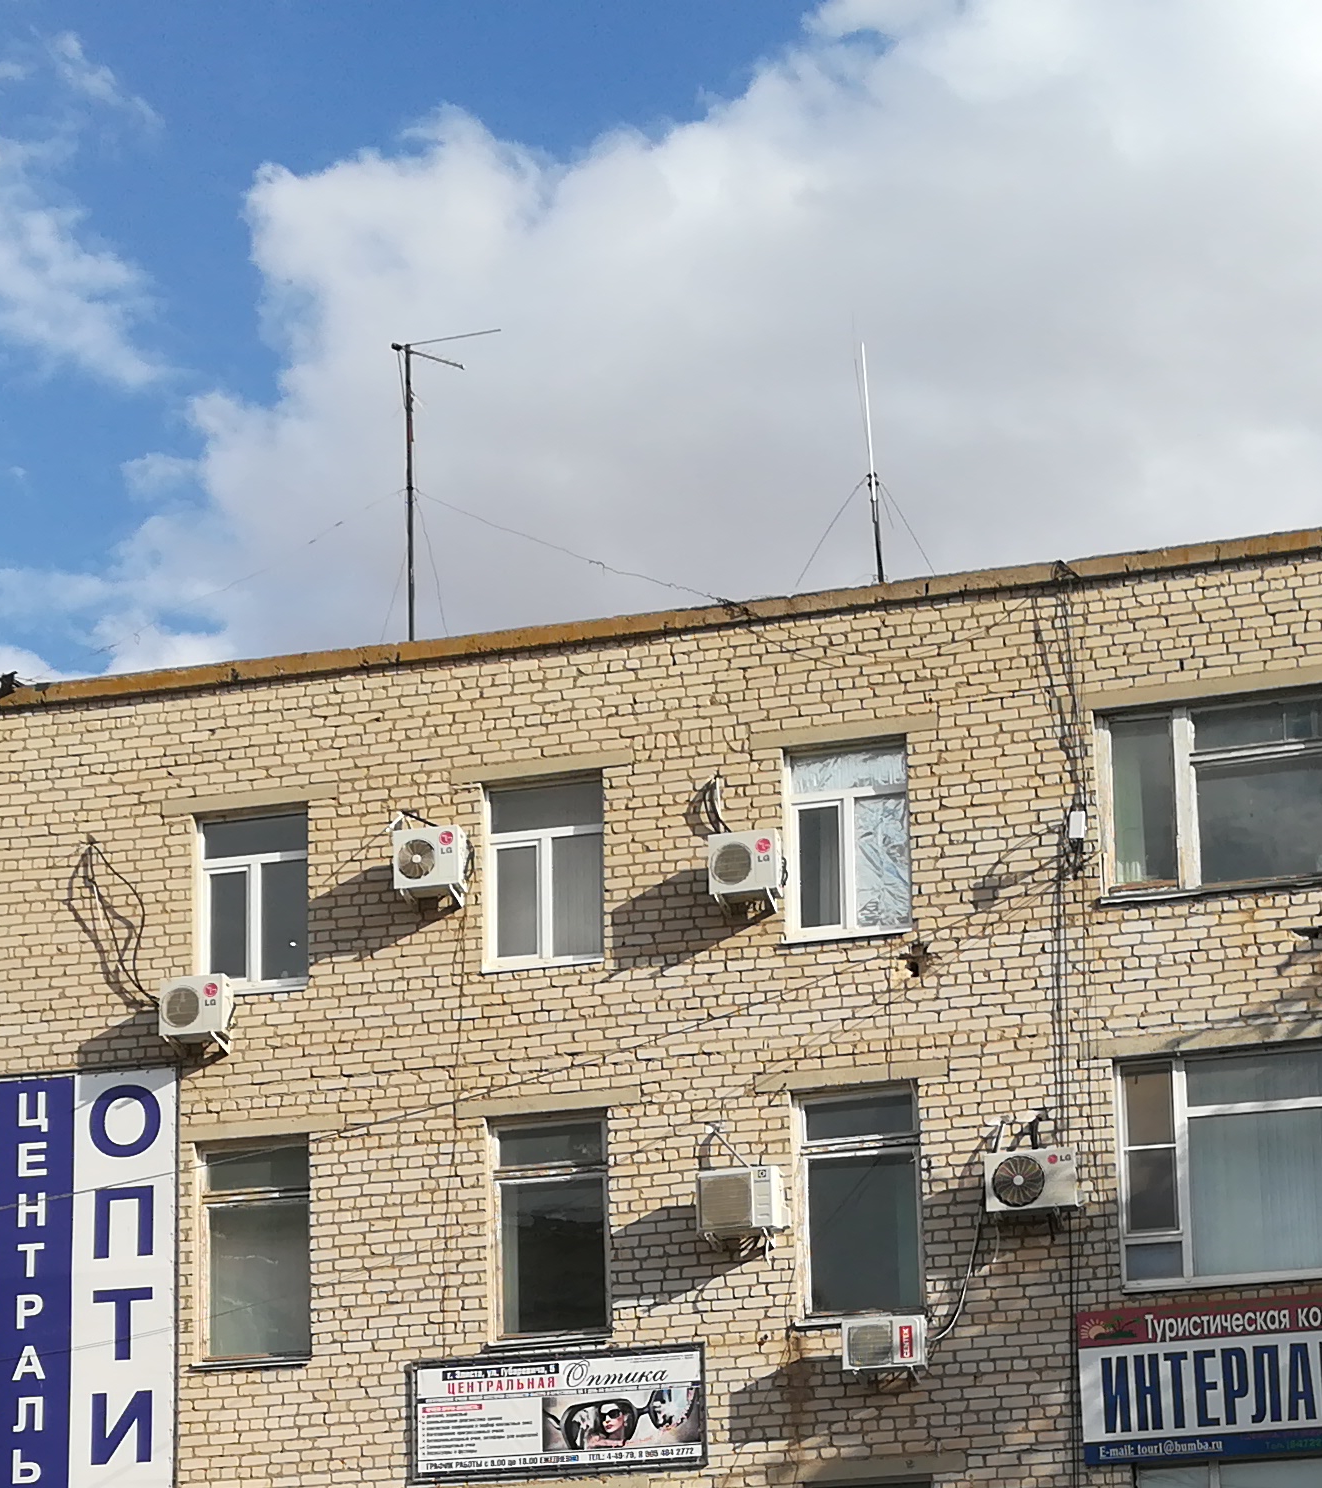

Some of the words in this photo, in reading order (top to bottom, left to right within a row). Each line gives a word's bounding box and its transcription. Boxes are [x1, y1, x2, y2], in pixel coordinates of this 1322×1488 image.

[1144, 1308, 1290, 1343] Туристическая
[563, 1359, 668, 1388] Оптика
[447, 1376, 556, 1396] ЦЕНТРАЛЬНАЯ
[1099, 1443, 1134, 1460] E-mail:
